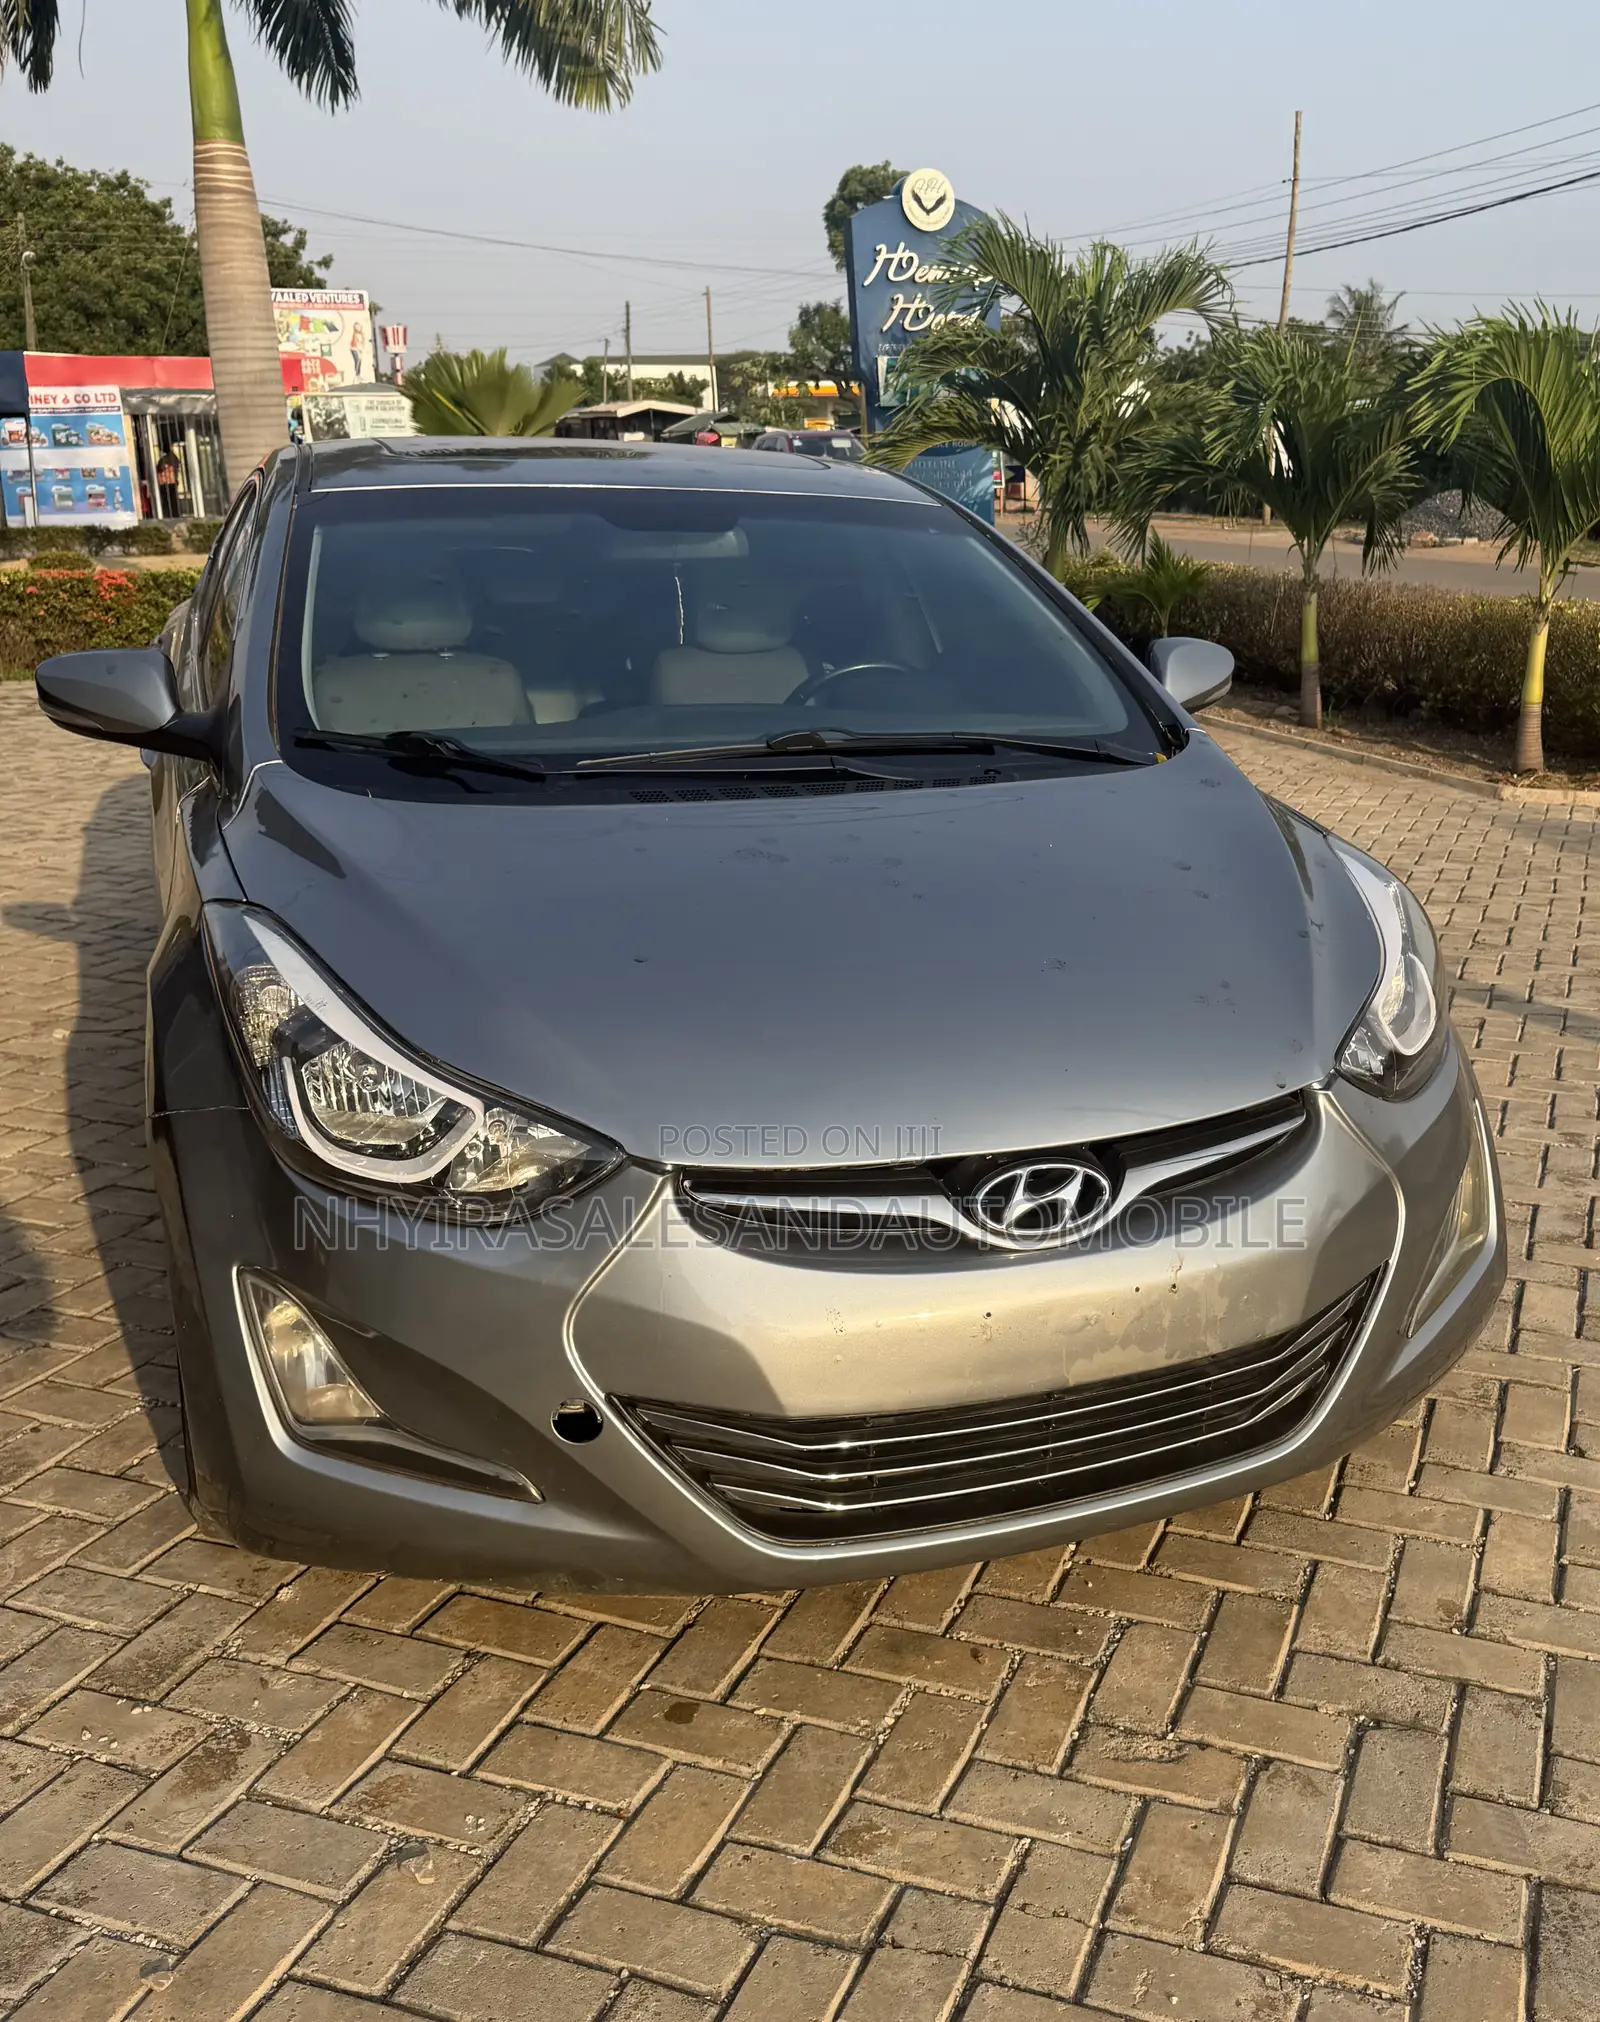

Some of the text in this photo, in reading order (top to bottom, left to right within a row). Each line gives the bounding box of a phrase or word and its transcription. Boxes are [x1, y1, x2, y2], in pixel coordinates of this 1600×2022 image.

[310, 292, 361, 304] VENTURES
[62, 394, 70, 404] &
[74, 393, 91, 404] CO
[94, 392, 117, 403] LTD
